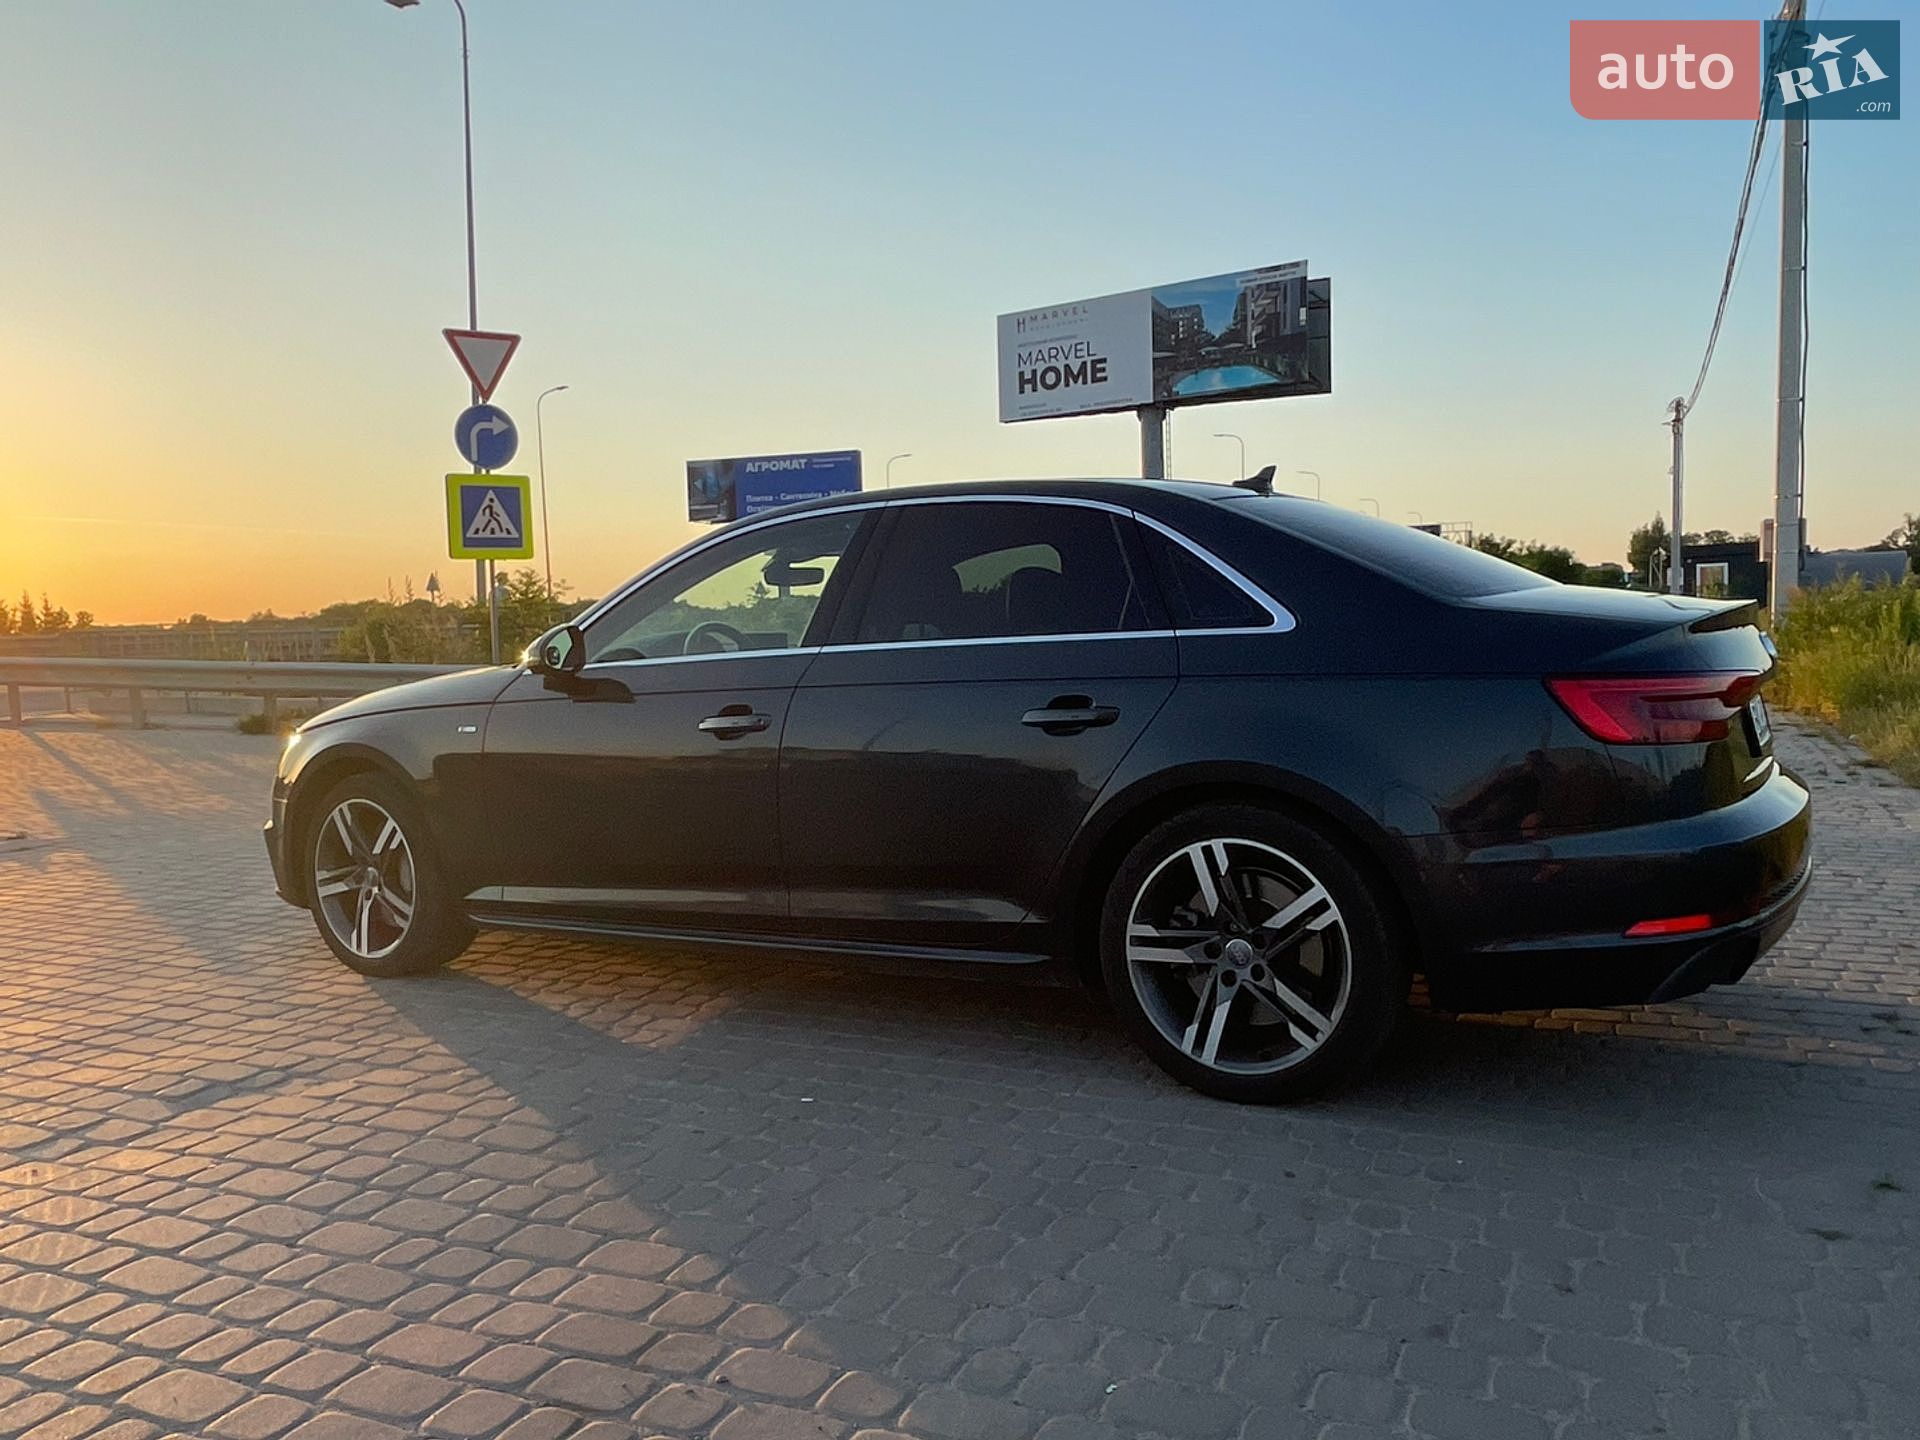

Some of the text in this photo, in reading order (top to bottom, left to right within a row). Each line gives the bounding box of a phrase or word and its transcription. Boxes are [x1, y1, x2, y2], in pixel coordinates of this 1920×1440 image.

[1030, 305, 1089, 321] MARVEL
[1018, 341, 1097, 368] MARVEL
[1018, 357, 1109, 395] HOME
[745, 459, 808, 473] АГРОМАТ
